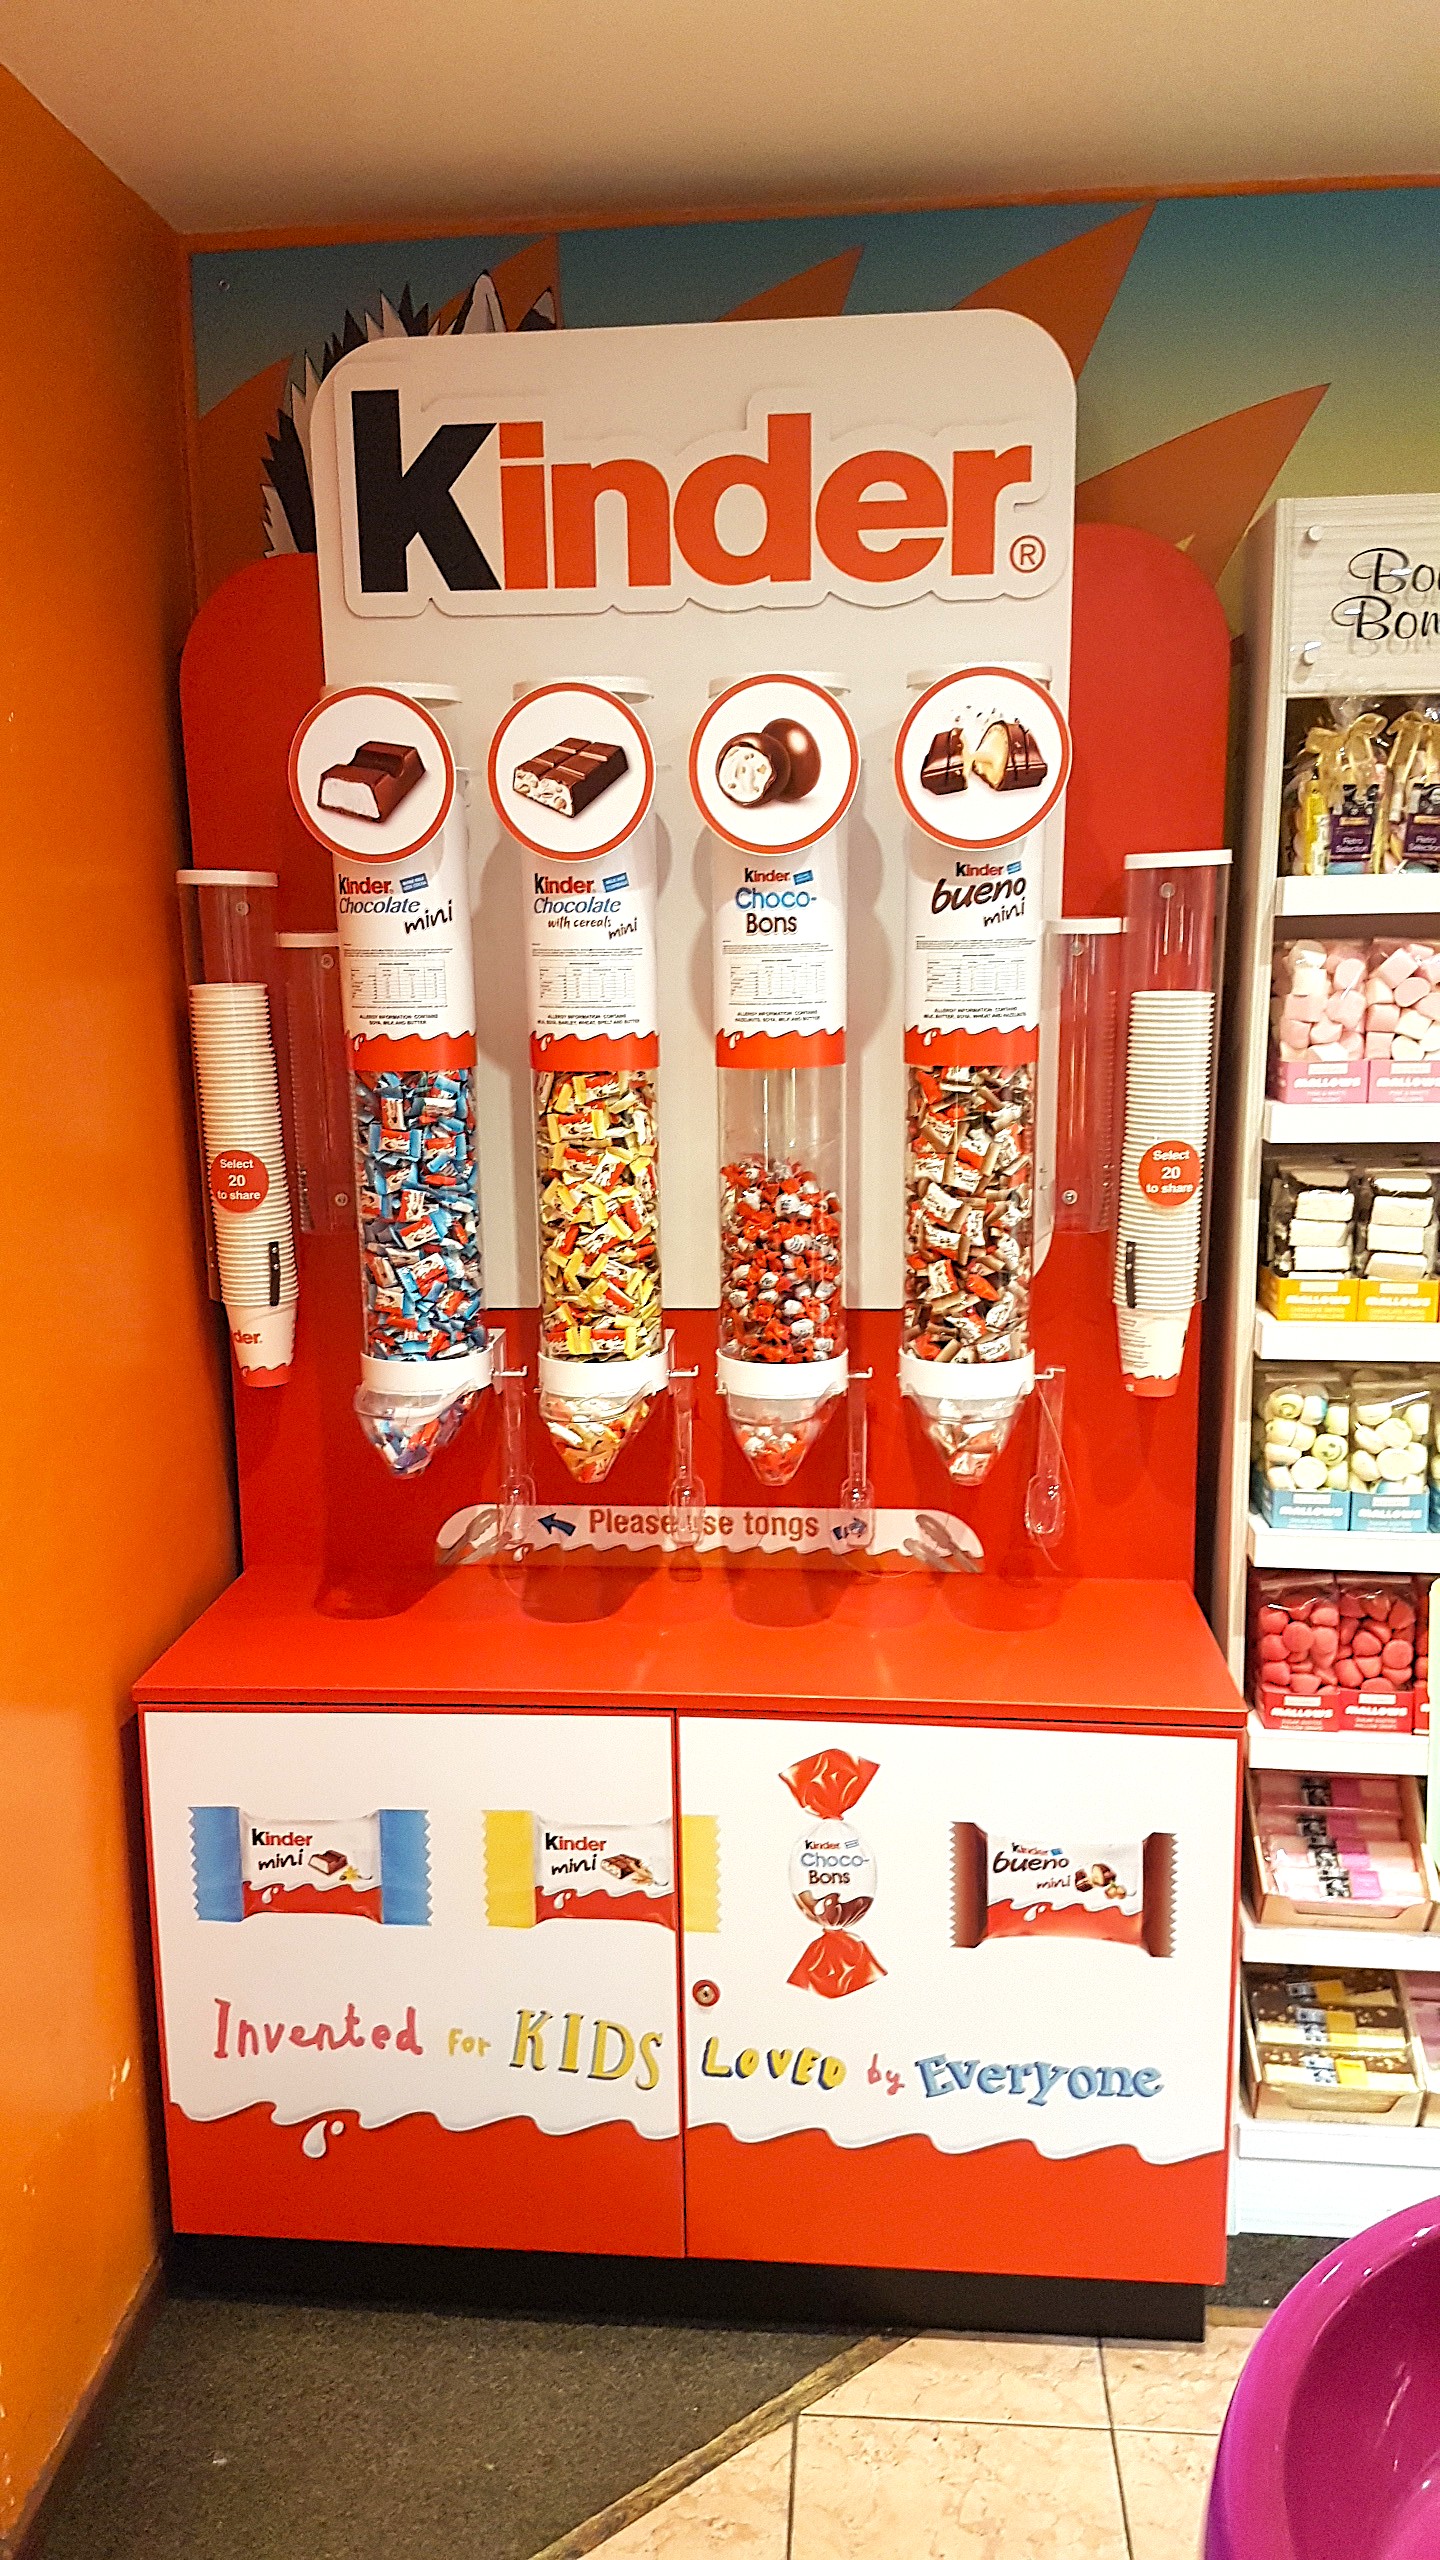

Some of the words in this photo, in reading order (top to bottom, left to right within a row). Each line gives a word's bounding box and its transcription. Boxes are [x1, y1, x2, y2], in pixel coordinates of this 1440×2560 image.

[1348, 547, 1440, 594] Bo
[339, 896, 421, 914] Chocolate
[533, 896, 622, 914] Chocolate
[735, 887, 817, 910] Choco-
[931, 877, 1027, 915] bueno
[404, 899, 453, 935] mini
[983, 896, 1026, 927] mini
[547, 916, 571, 929] with
[573, 915, 612, 929] cereals
[608, 917, 638, 940] mini
[746, 912, 798, 934] Bons
[219, 1158, 255, 1169] Select
[1152, 1149, 1190, 1161] Select
[228, 1174, 246, 1187] 20
[1161, 1166, 1181, 1180] 20
[217, 1190, 228, 1200] to
[229, 1190, 261, 1200] share
[1145, 1183, 1159, 1193] to
[1160, 1182, 1194, 1194] share
[589, 1508, 676, 1535] Please
[743, 1511, 820, 1541] tongs
[258, 1849, 304, 1871] mini
[551, 1854, 597, 1876] mini
[800, 1852, 870, 1868] Choco-
[992, 1851, 1070, 1874] bueno
[808, 1869, 851, 1885] Bons
[1036, 1874, 1071, 1890] mini
[213, 1998, 424, 2060] Invented
[509, 2008, 664, 2091] KIDS
[701, 2036, 847, 2091] LOVED
[866, 2052, 905, 2096] by
[915, 2053, 1165, 2107] Everyone
